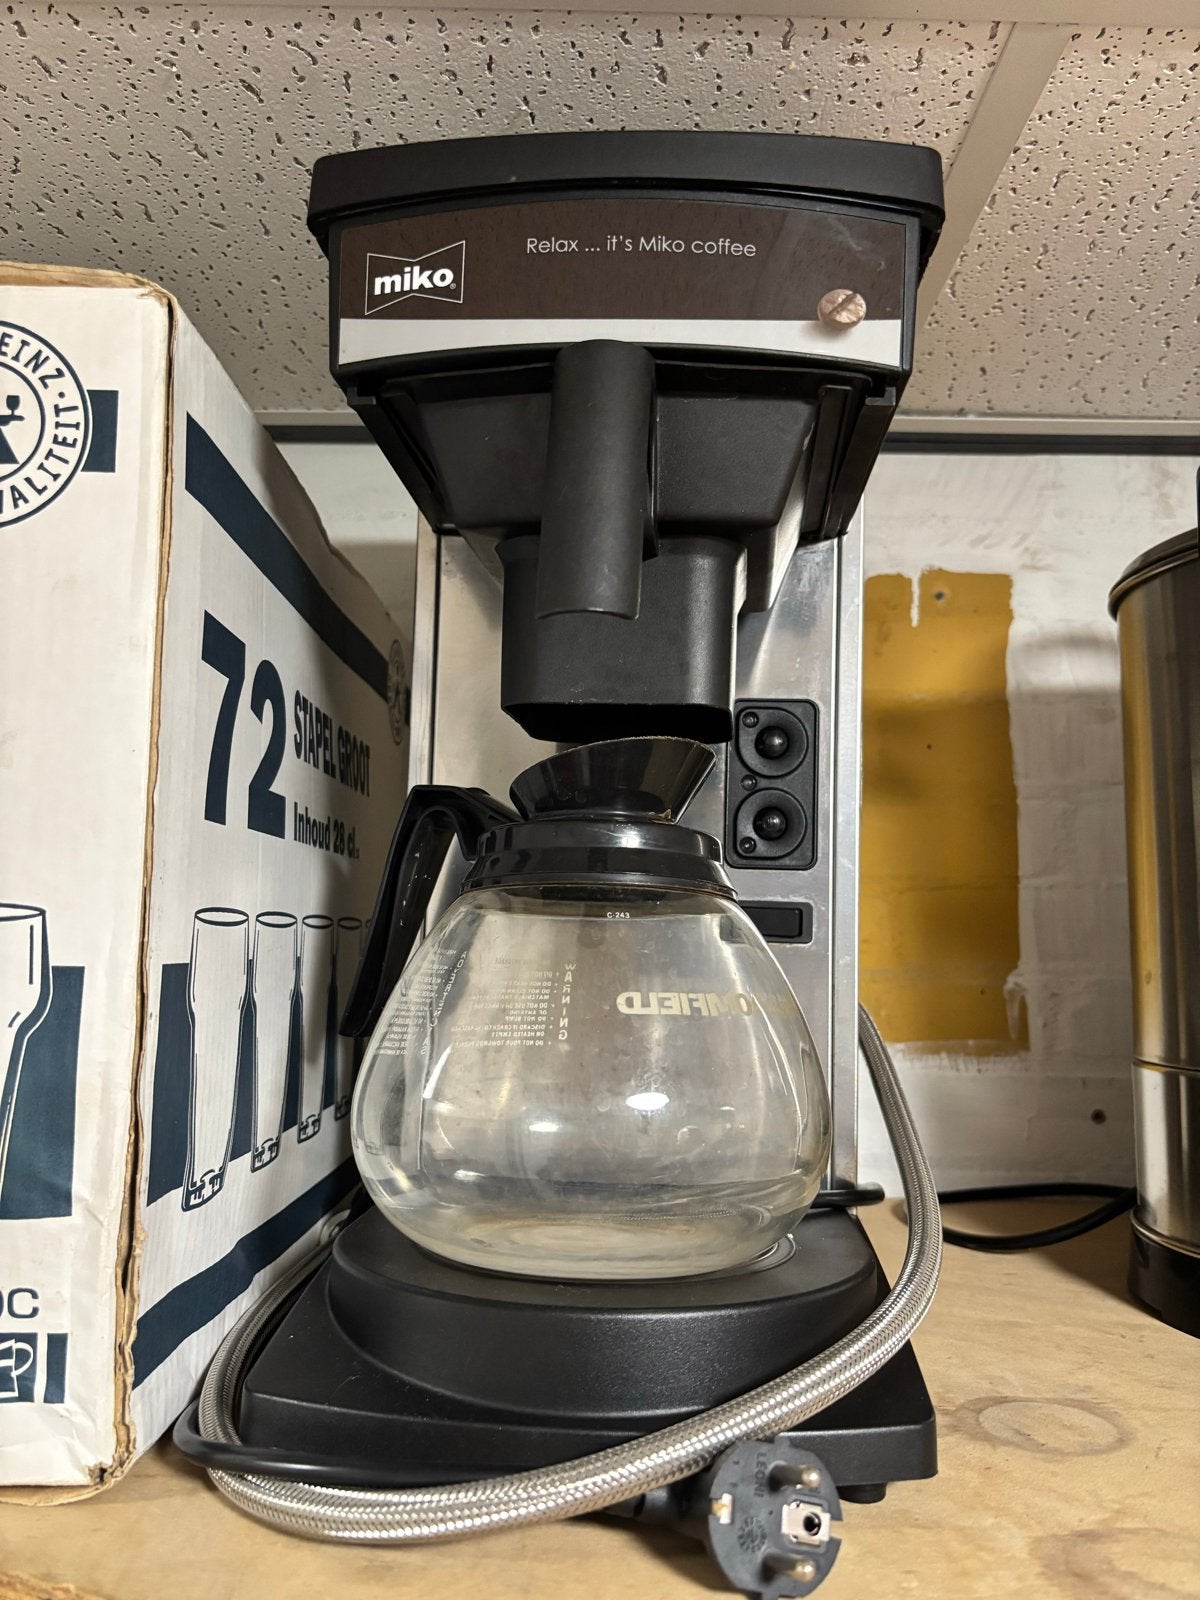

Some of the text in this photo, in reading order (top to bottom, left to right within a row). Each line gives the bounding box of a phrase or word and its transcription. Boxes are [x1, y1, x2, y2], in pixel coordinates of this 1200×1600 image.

[526, 237, 579, 254] Relax
[606, 235, 633, 253] it's
[639, 235, 685, 254] Miko
[691, 236, 757, 257] coffee
[0, 403, 80, 514] ALITEIT
[201, 609, 286, 839] 72
[294, 689, 337, 780] STAPEL
[337, 724, 371, 798] GROOT
[293, 801, 331, 852] Inhoud
[333, 819, 345, 856] 28
[606, 911, 630, 919] C-243
[0, 1287, 40, 1319] C
